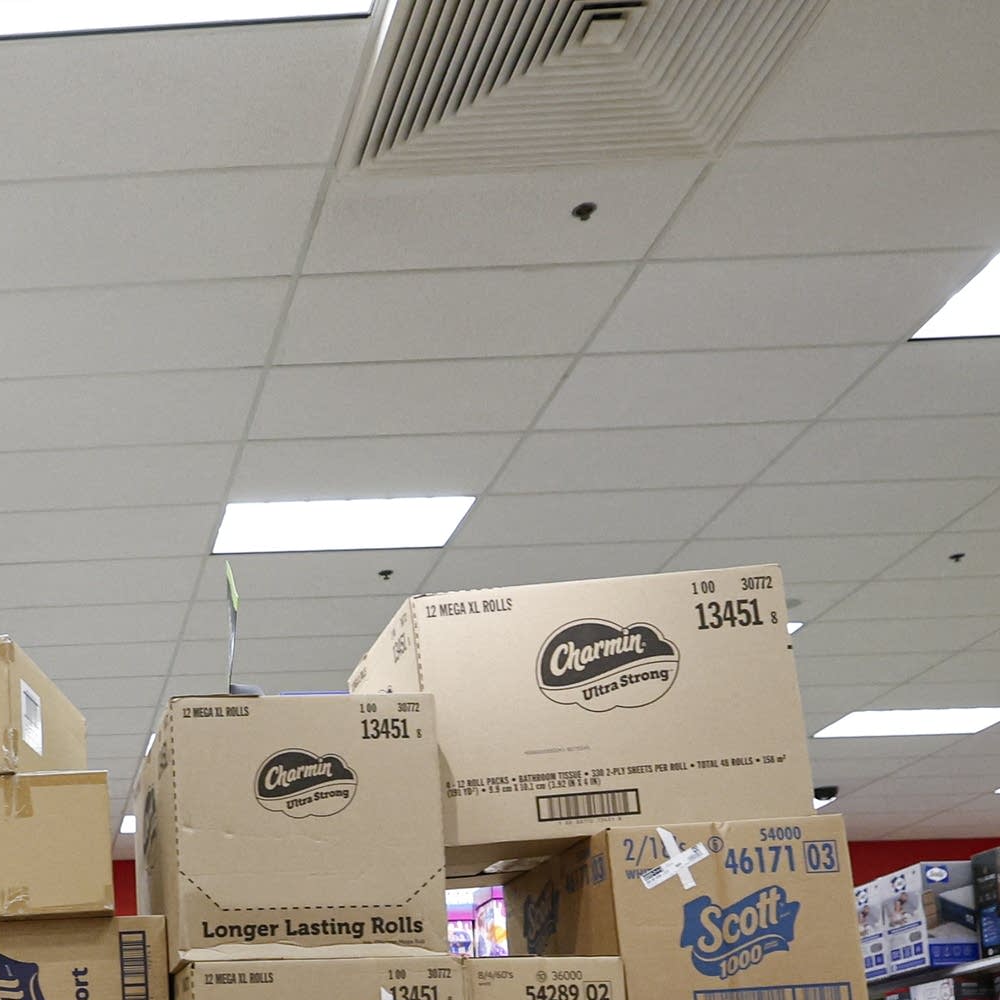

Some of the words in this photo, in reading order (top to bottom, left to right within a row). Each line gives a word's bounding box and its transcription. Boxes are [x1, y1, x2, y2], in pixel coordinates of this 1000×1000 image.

[742, 576, 773, 590] 30772
[426, 605, 437, 618] 12
[440, 603, 466, 617] MEGA
[468, 601, 480, 614] XL
[482, 598, 512, 613] ROLLS
[695, 599, 764, 629] 13451
[770, 611, 778, 624] 8
[550, 629, 644, 676] Charmin
[582, 679, 619, 700] Ultra
[619, 667, 669, 689] Strong
[183, 708, 191, 718] 12
[193, 707, 213, 717] MEGA
[215, 707, 224, 717] XL
[226, 706, 249, 717] ROLLS
[397, 703, 420, 712] 30772
[361, 719, 410, 739] 13451
[264, 759, 332, 790] Charmin
[486, 776, 509, 785] PACKS
[519, 772, 556, 783] BATHROOM
[557, 770, 581, 779] TISSUE
[627, 765, 653, 775] SHEETS
[654, 763, 668, 772] PER
[670, 762, 687, 771] ROLL
[697, 760, 718, 768] TOTAL
[731, 757, 753, 766] ROLLS
[287, 796, 312, 810] Ultra
[314, 788, 349, 803] Strong
[760, 827, 801, 841] 54000
[725, 845, 796, 874] 46171
[808, 843, 836, 871] 03
[202, 920, 279, 941] Longer
[285, 917, 365, 938] Lasting
[371, 917, 423, 934] Rolls
[699, 887, 781, 953] Scott
[720, 945, 763, 980] 1000
[205, 976, 213, 984] 12
[215, 974, 236, 984] MEGA
[239, 973, 248, 983] XL
[249, 972, 273, 983] ROLLS
[552, 970, 582, 981] 36000
